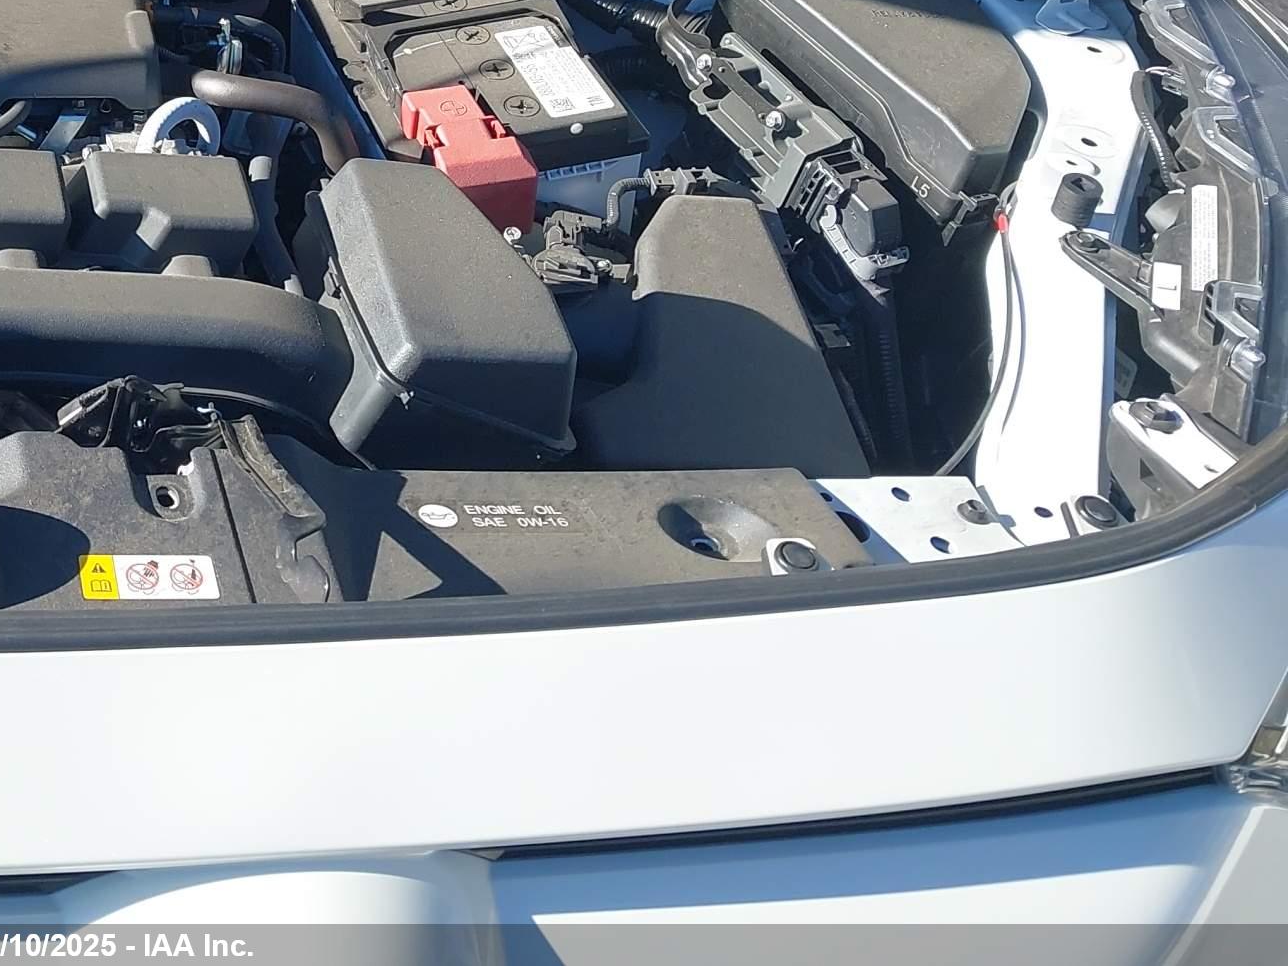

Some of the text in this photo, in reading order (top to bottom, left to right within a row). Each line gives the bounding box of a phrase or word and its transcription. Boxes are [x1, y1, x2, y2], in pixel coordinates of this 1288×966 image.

[911, 175, 930, 198] L5
[463, 505, 562, 515] ENGINE OIL
[471, 517, 569, 527] SAE 0W-16
